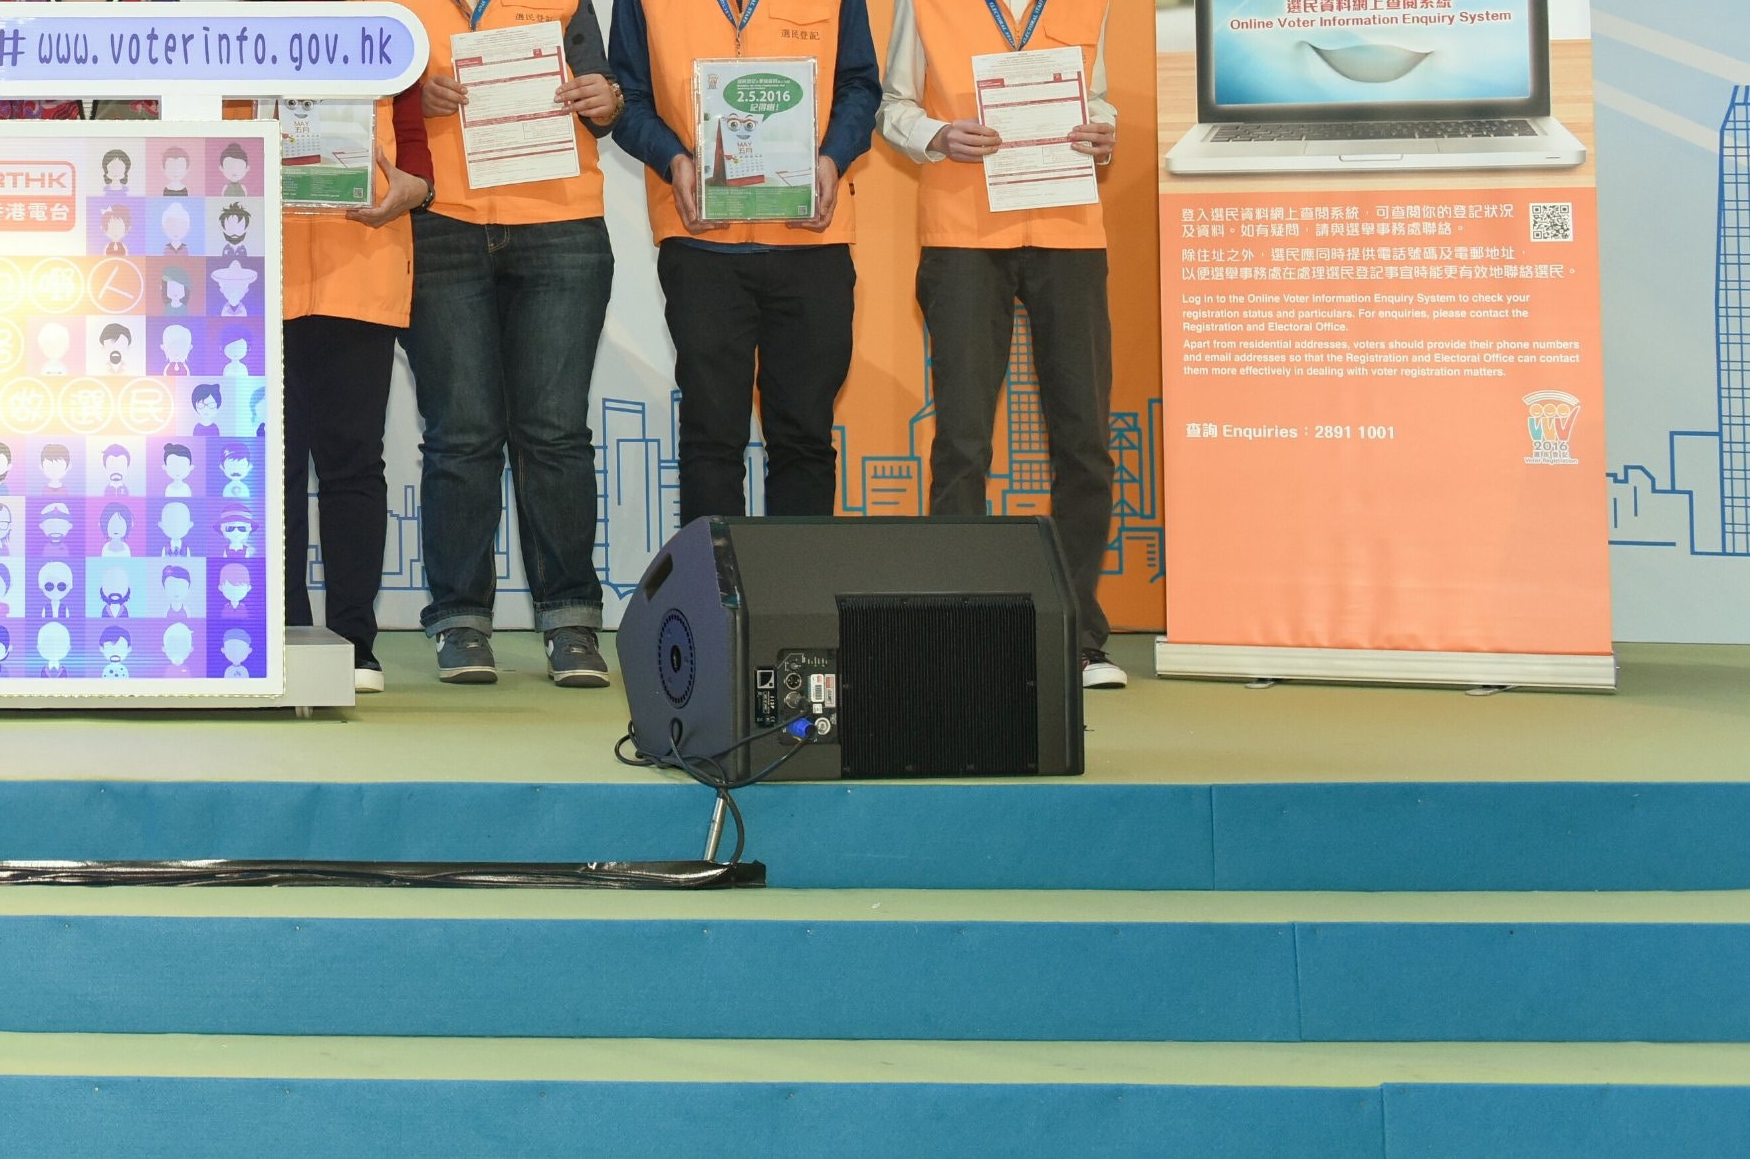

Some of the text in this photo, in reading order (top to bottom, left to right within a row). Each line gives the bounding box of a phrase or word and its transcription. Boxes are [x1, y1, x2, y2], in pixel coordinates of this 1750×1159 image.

[1230, 10, 1511, 30] Online Voter Information Enquiry System
[738, 90, 790, 102] 2.5.2016
[1182, 292, 1531, 306] Log in to the Online Voter Information Enquiry System to check your
[1182, 308, 1530, 320] registration status and particulars. For enquiries, please contact the
[1182, 322, 1348, 333] Registration and Electoral Office.
[1186, 422, 1218, 438] 查詢
[1314, 424, 1351, 440] 2891
[1358, 426, 1394, 440] 1001
[1534, 442, 1568, 450] 2016
